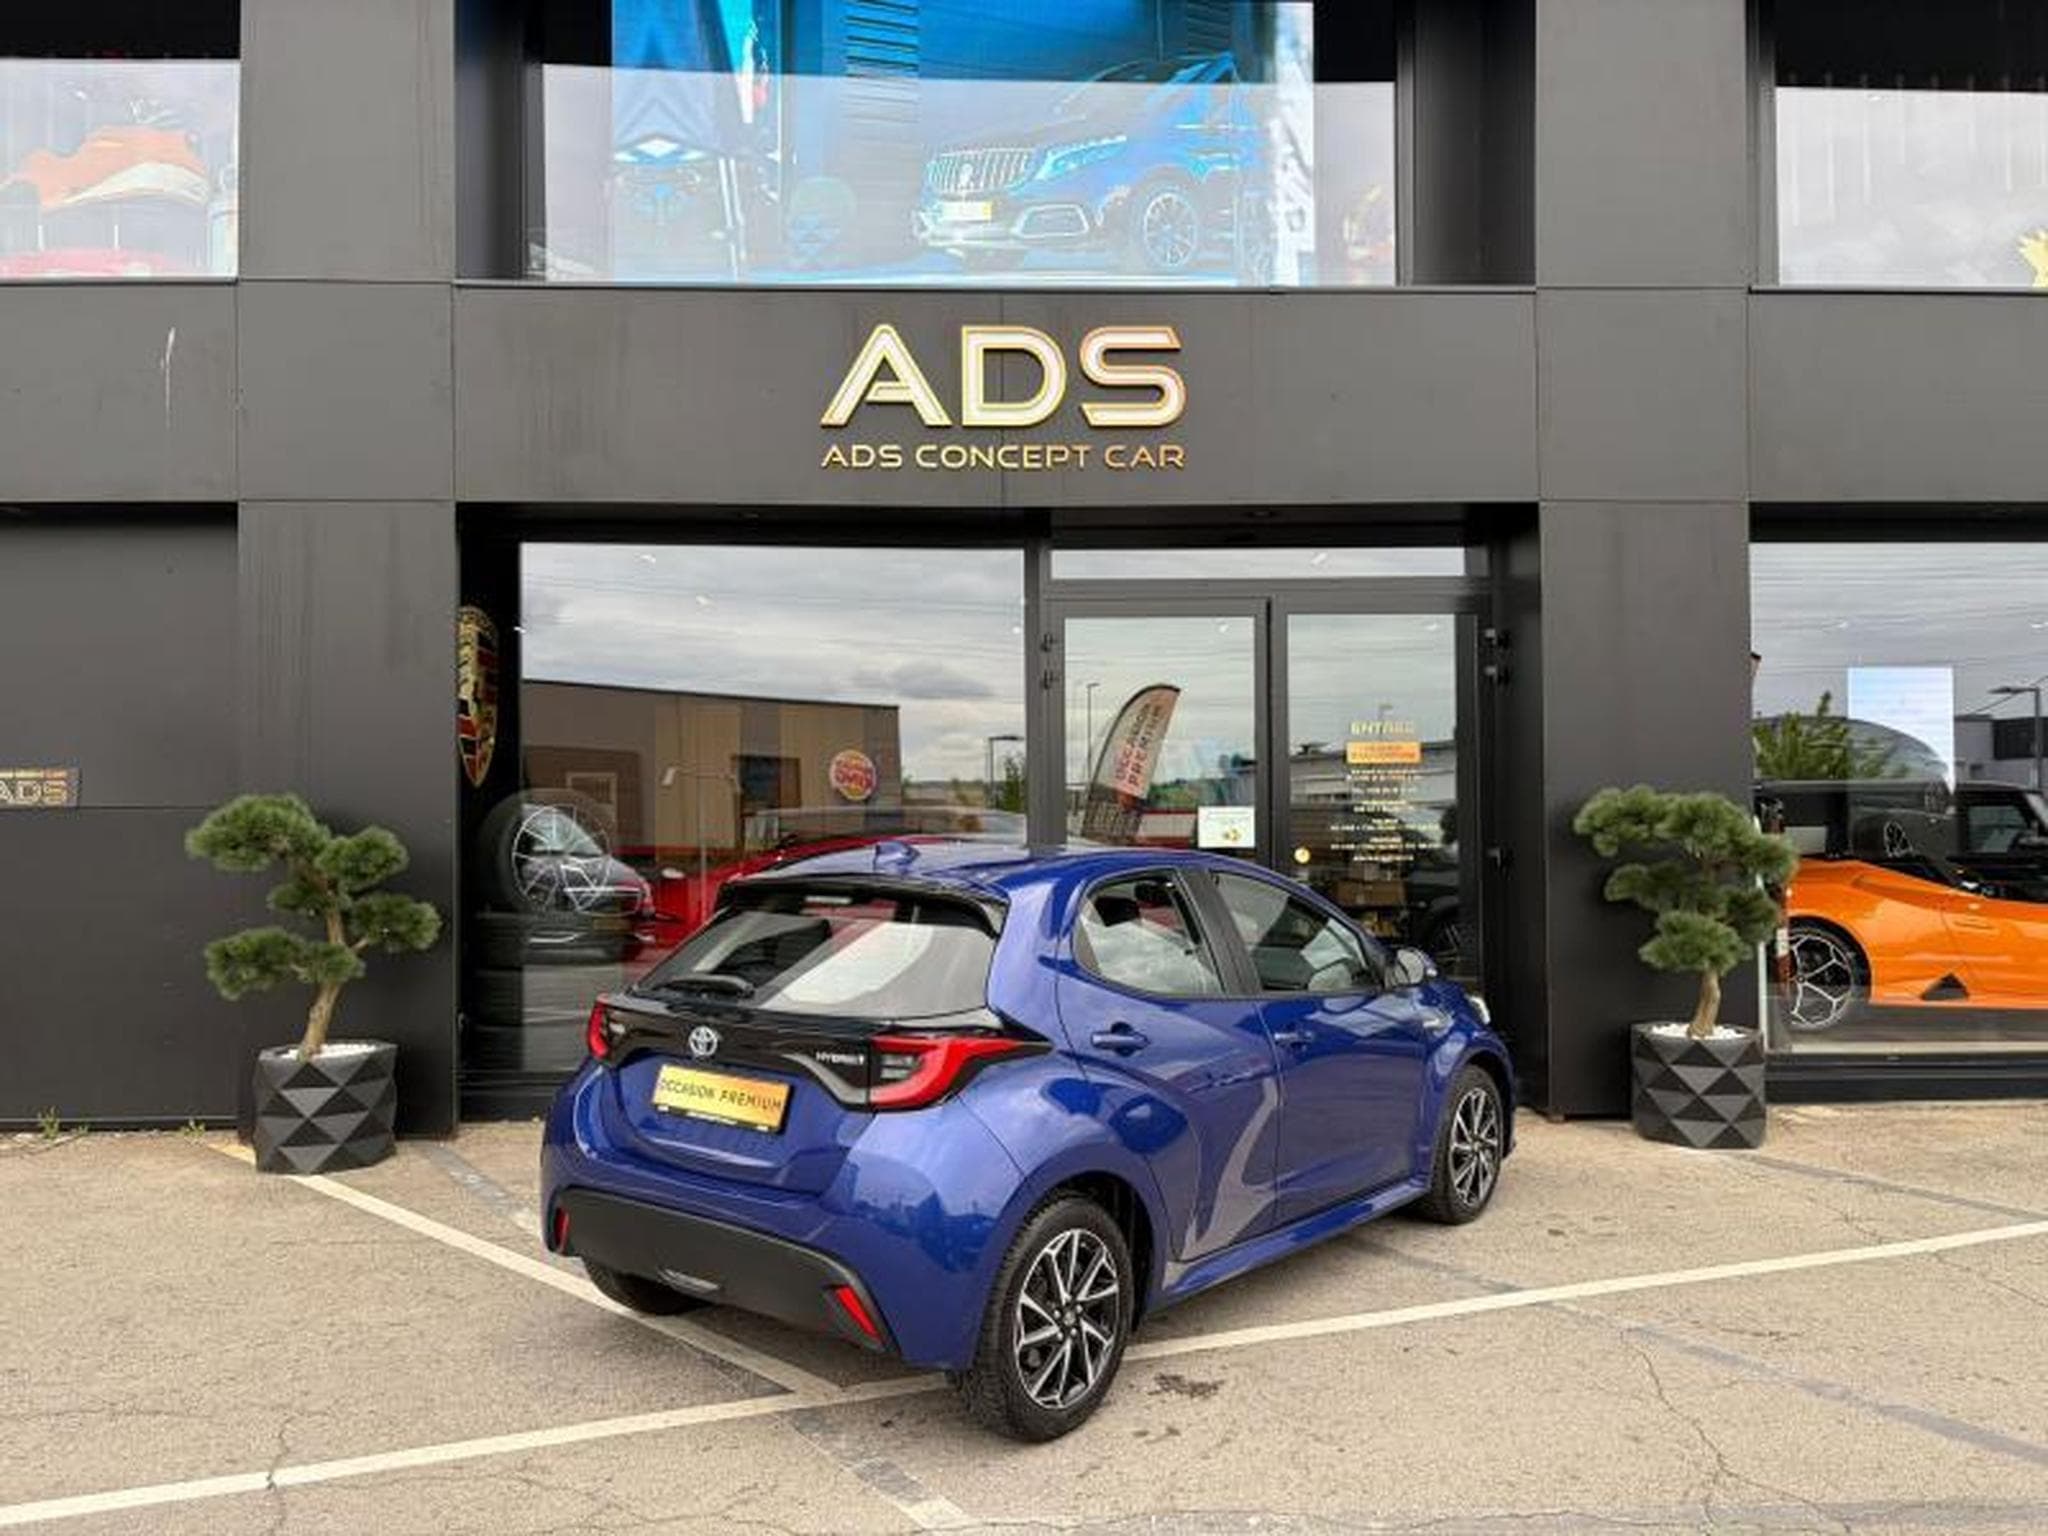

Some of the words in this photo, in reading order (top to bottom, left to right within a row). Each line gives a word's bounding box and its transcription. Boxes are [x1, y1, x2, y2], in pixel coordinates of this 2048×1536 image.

[820, 323, 1187, 428] ADS
[820, 443, 903, 469] ADS
[914, 443, 1094, 469] CONCEPT
[1103, 443, 1186, 469] CAR
[659, 1077, 716, 1099] OCCASION
[718, 1089, 782, 1110] PREMIUM
